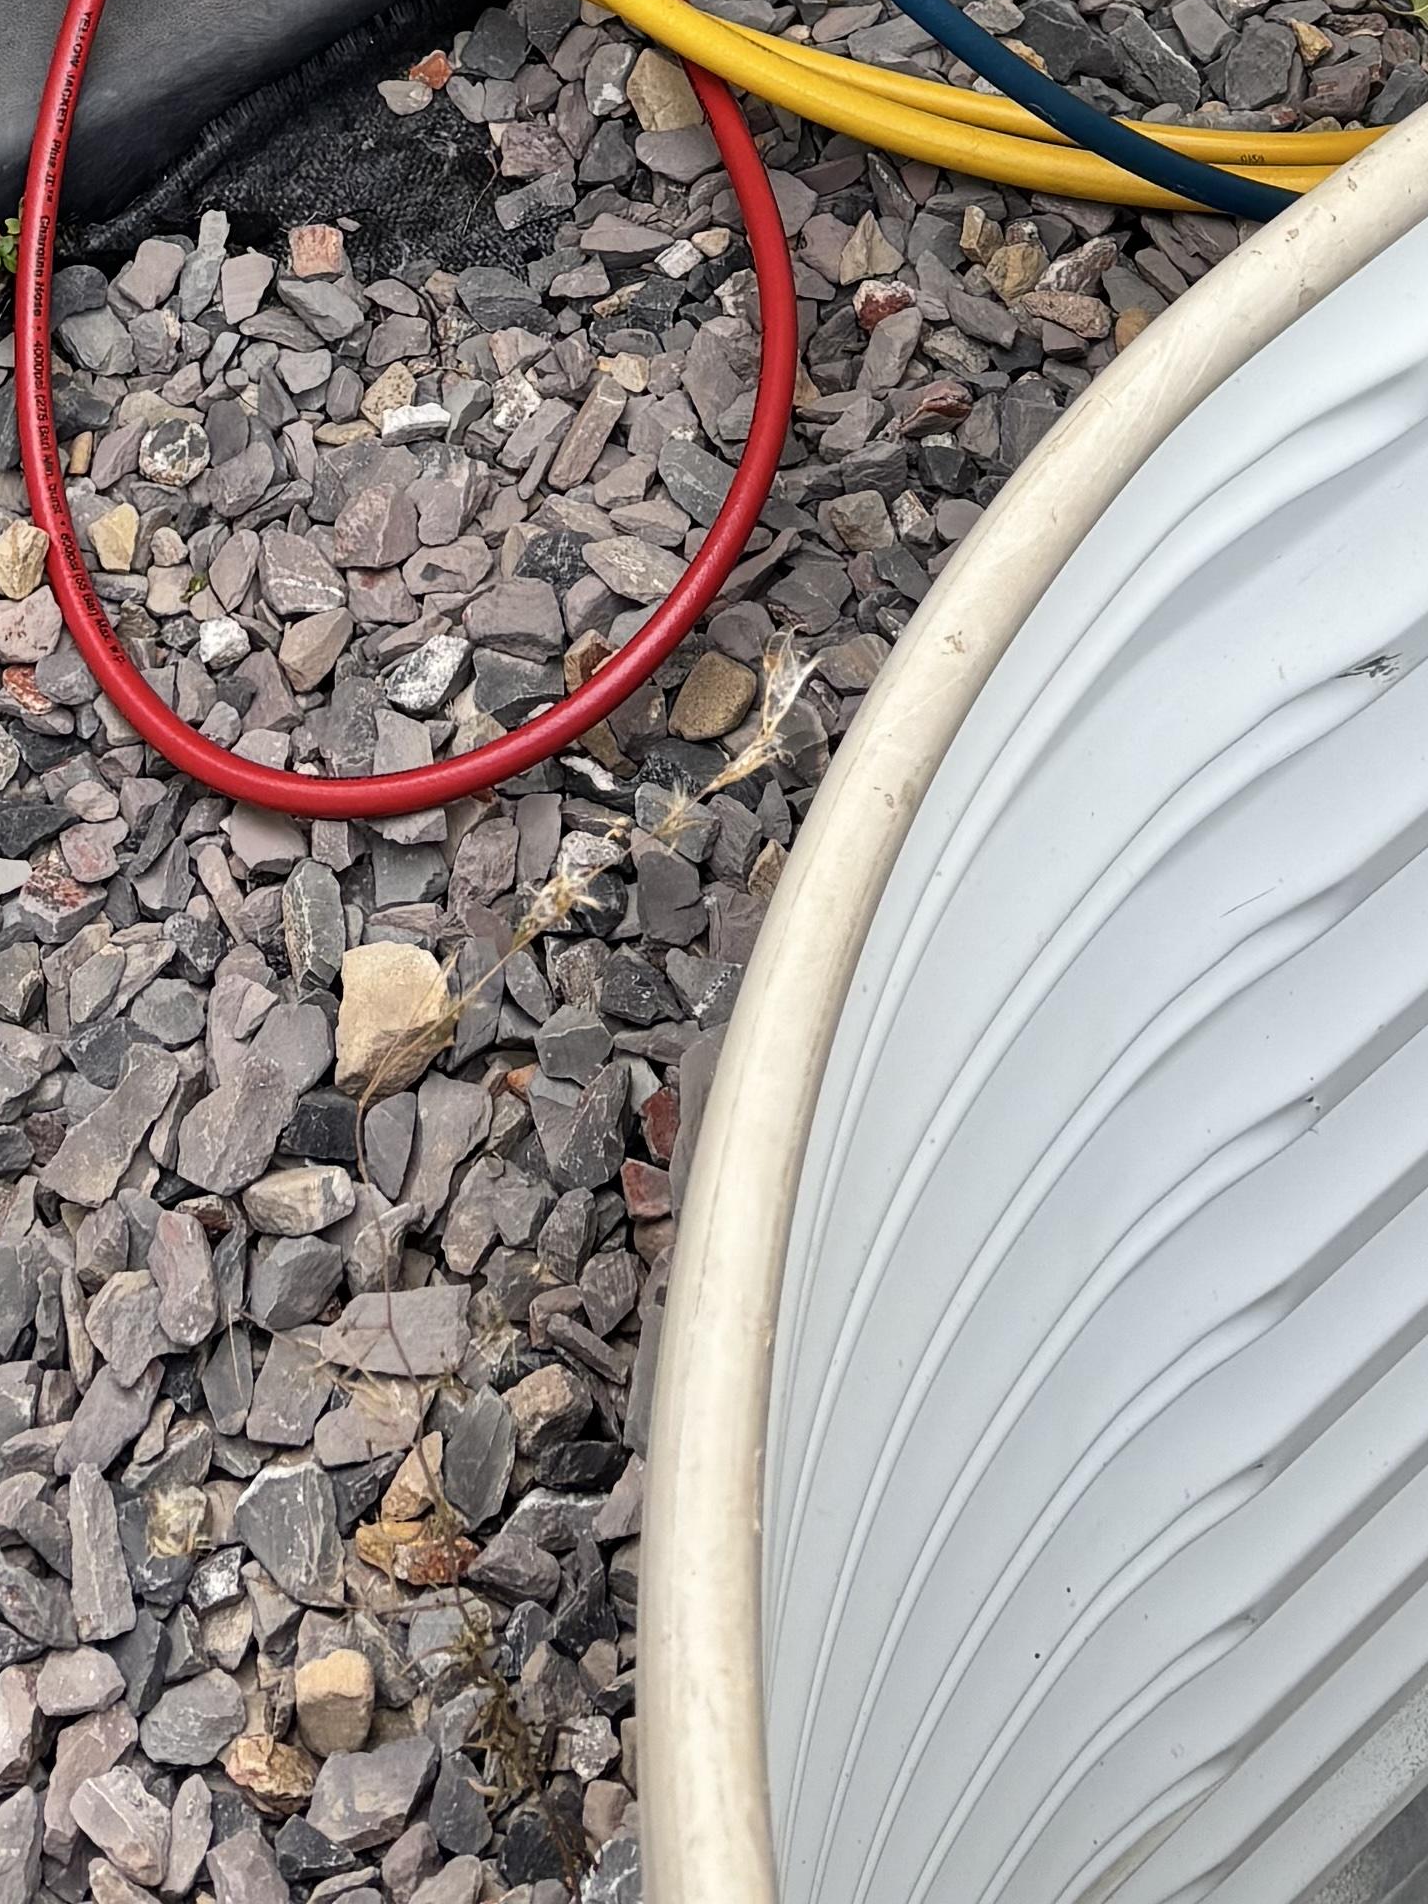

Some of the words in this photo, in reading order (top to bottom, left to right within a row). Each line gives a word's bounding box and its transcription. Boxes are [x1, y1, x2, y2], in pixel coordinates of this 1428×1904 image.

[70, 10, 93, 68] YELLOW
[33, 215, 50, 277] Charging
[33, 281, 45, 317] Hose
